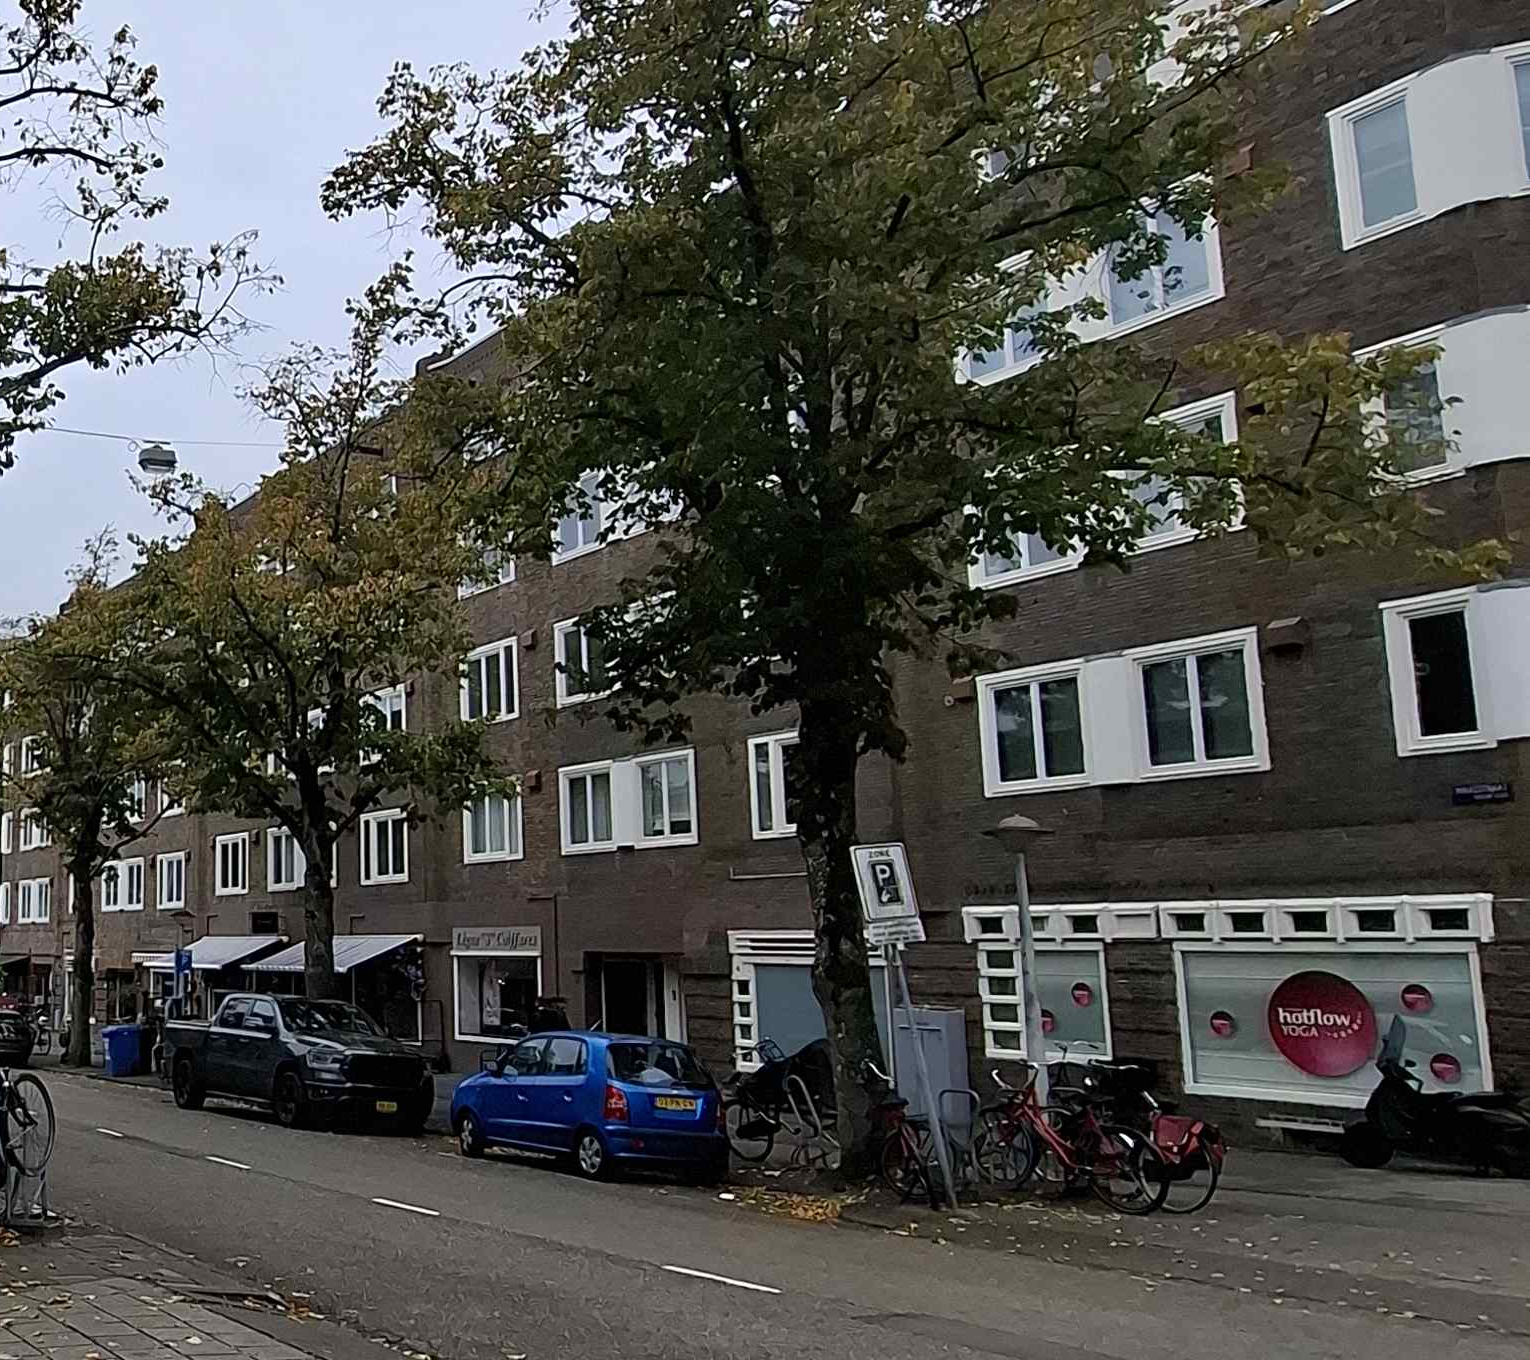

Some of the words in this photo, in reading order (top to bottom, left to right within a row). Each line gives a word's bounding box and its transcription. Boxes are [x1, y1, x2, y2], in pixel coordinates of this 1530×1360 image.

[875, 863, 891, 887] P
[1277, 1006, 1351, 1027] hotflow
[1281, 1025, 1319, 1038] YOGA
